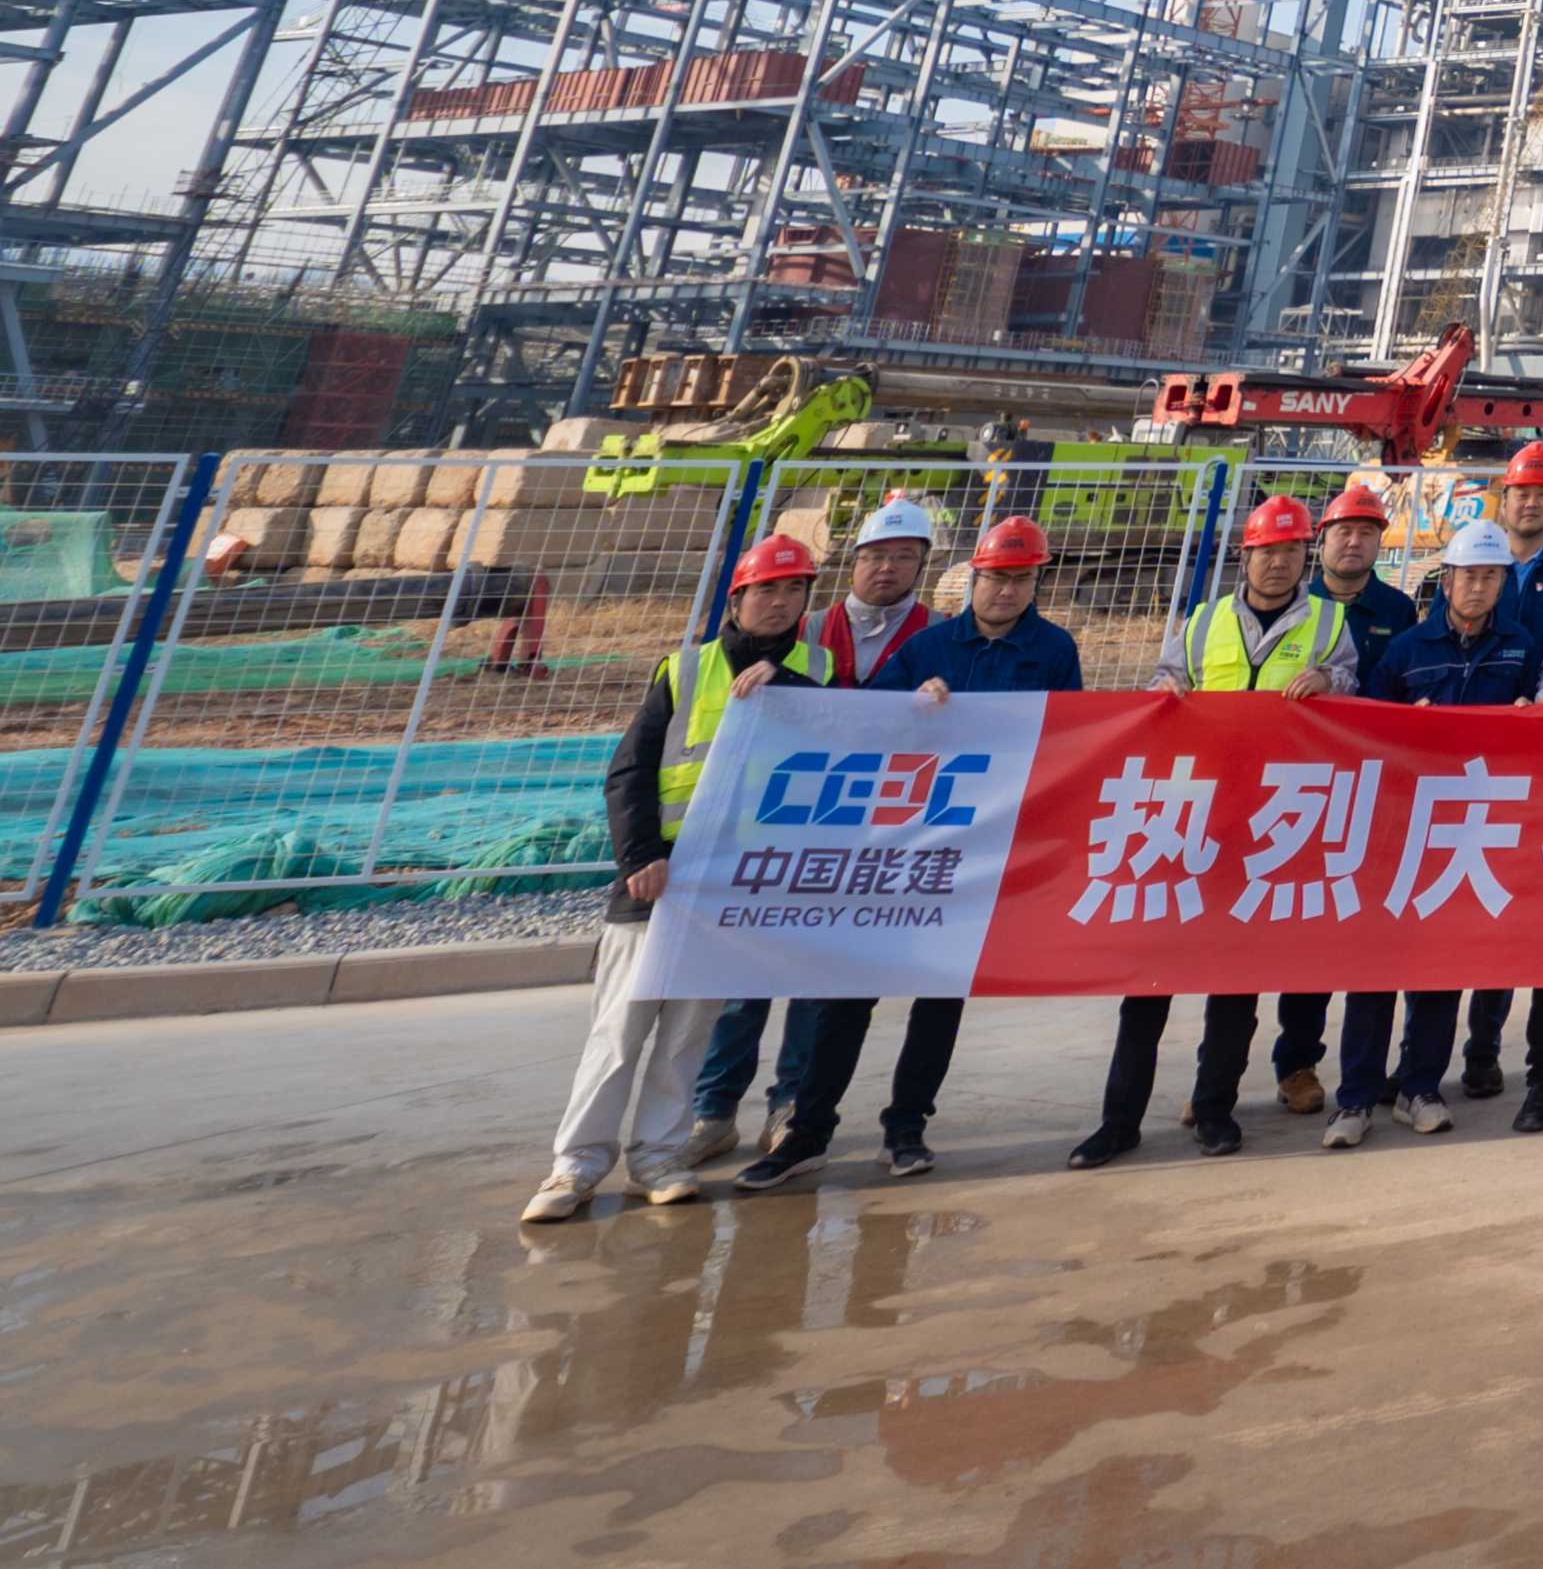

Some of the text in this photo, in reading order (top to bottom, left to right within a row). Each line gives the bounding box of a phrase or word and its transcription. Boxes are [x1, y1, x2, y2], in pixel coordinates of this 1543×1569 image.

[1280, 391, 1353, 414] SANY
[755, 752, 991, 826] CEEC
[730, 846, 962, 895] 中国能建
[718, 906, 944, 927] ENERGY CHINA
